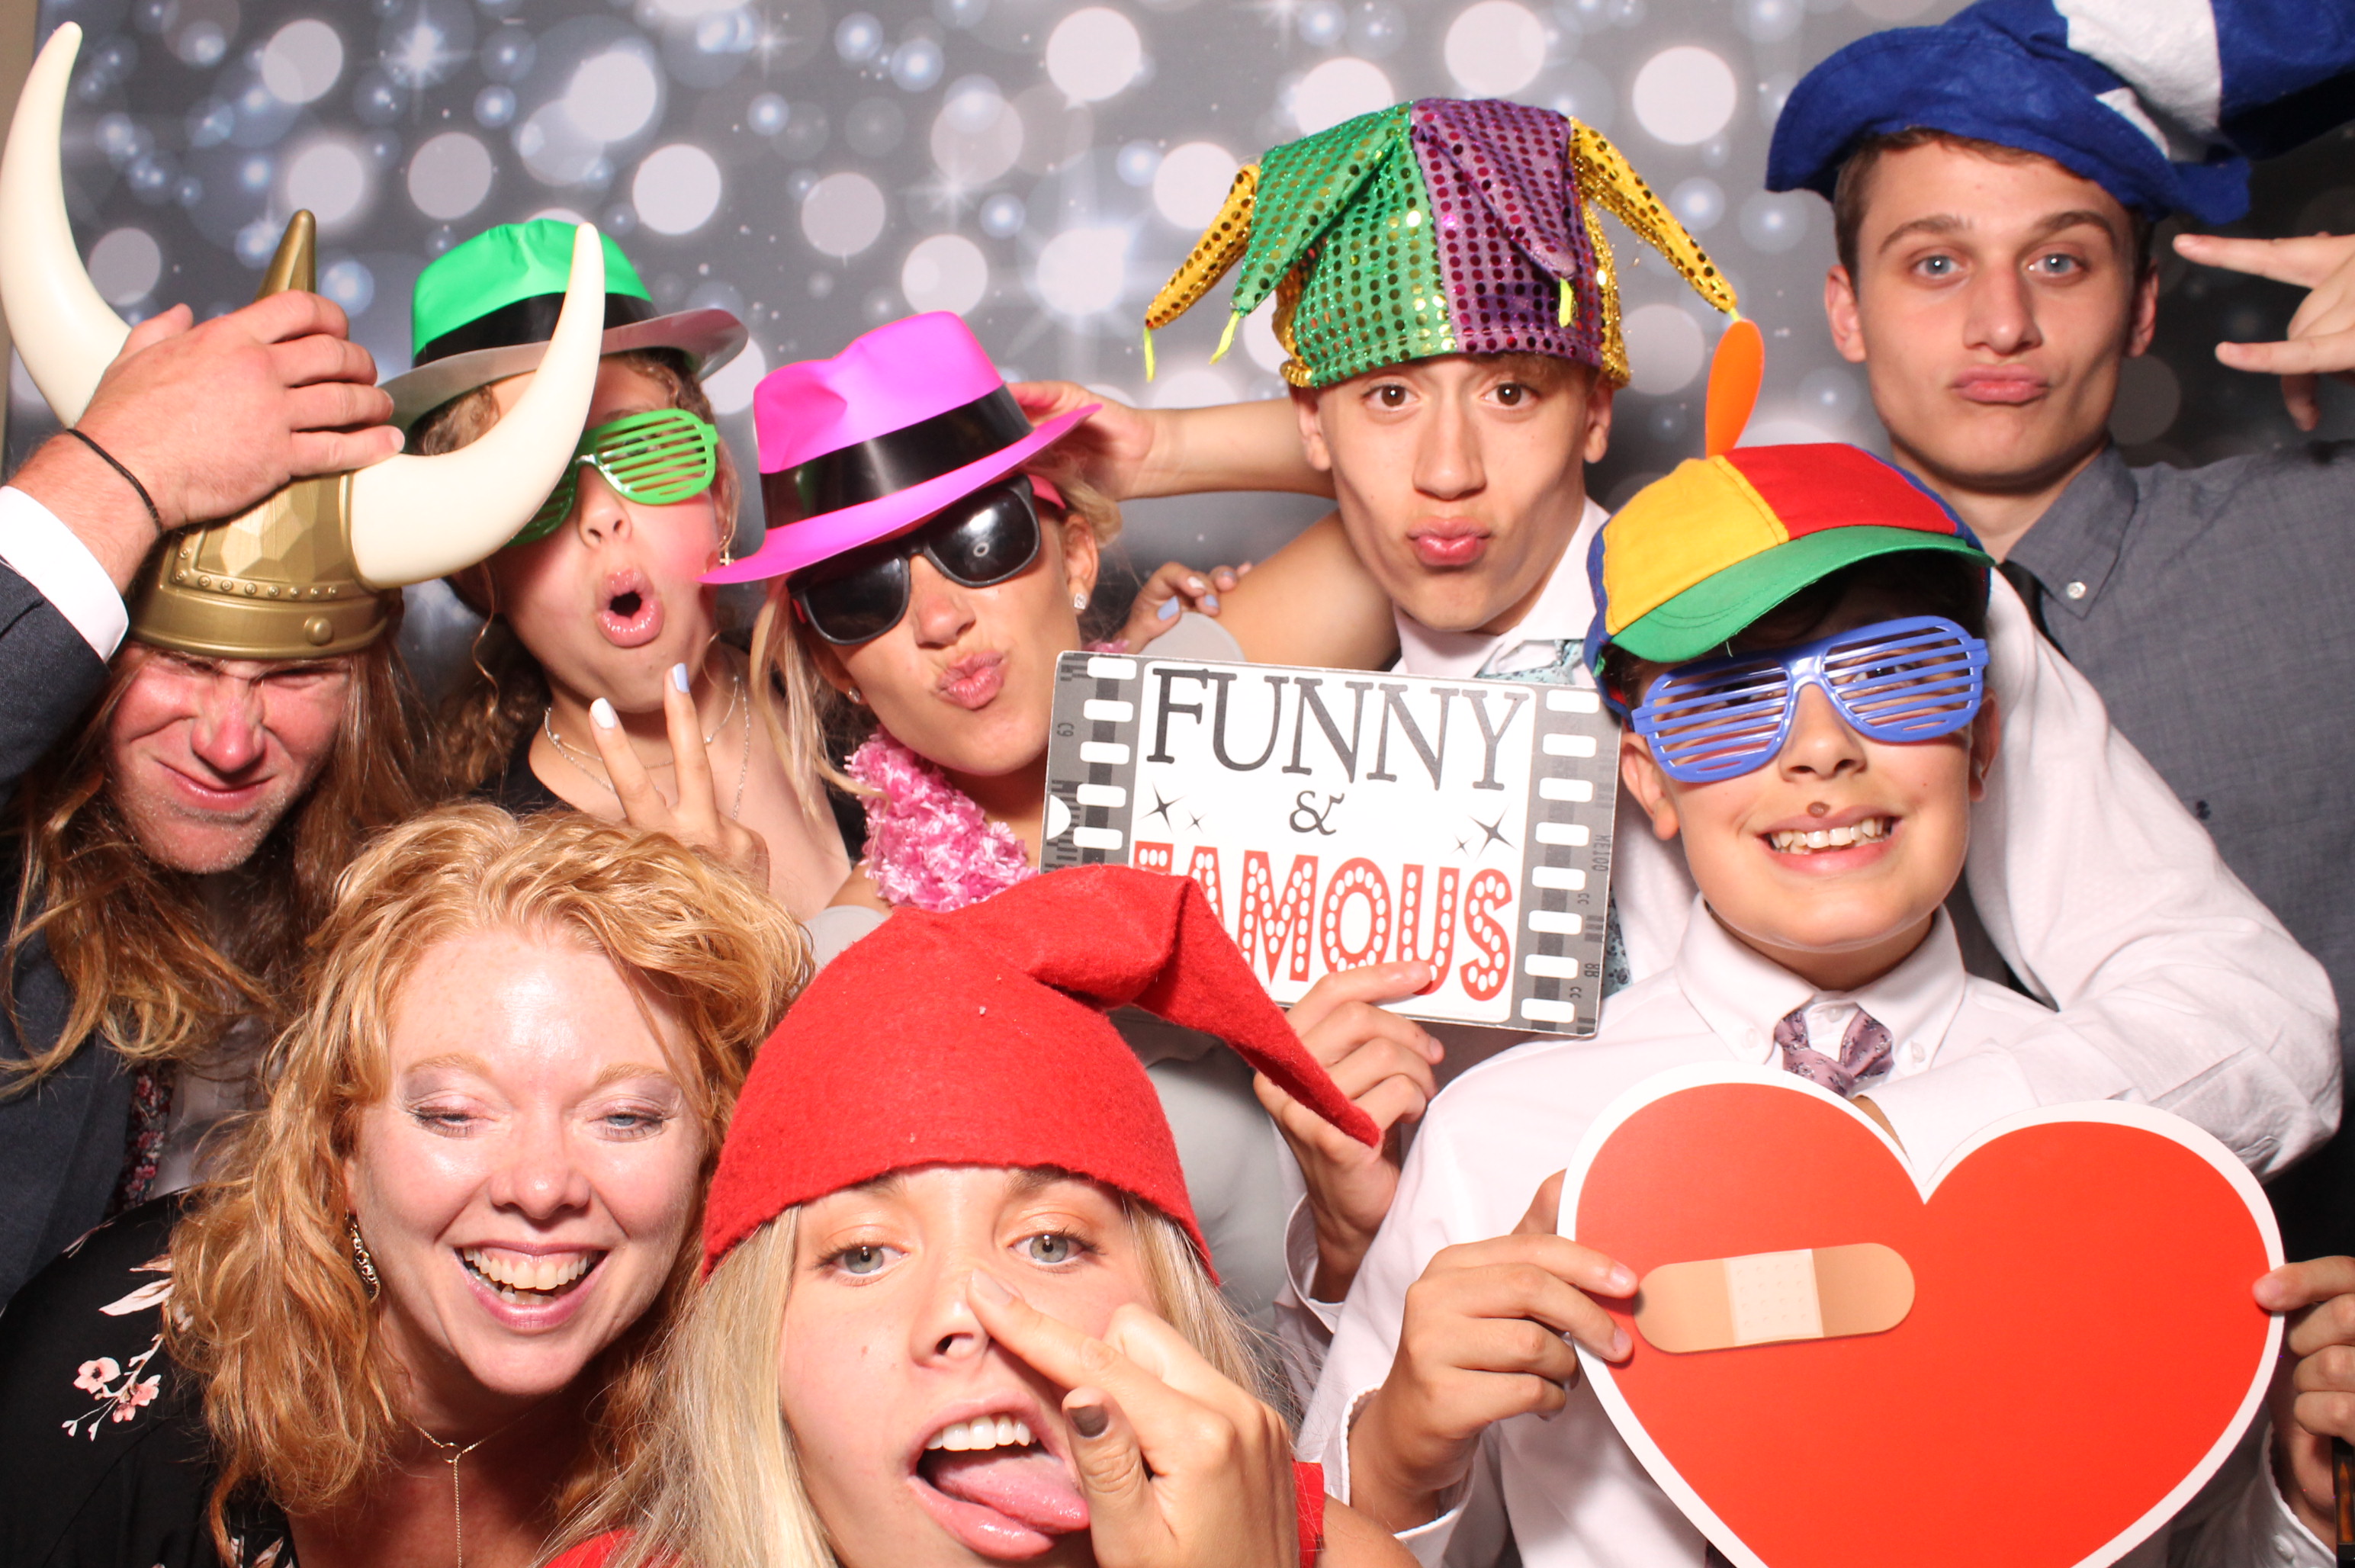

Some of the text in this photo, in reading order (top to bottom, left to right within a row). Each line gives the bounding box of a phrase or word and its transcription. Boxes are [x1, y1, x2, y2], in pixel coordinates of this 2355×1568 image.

[1146, 668, 1528, 791] FUNNY
[1290, 790, 1345, 836] &
[1135, 840, 1513, 1001] MOUS
